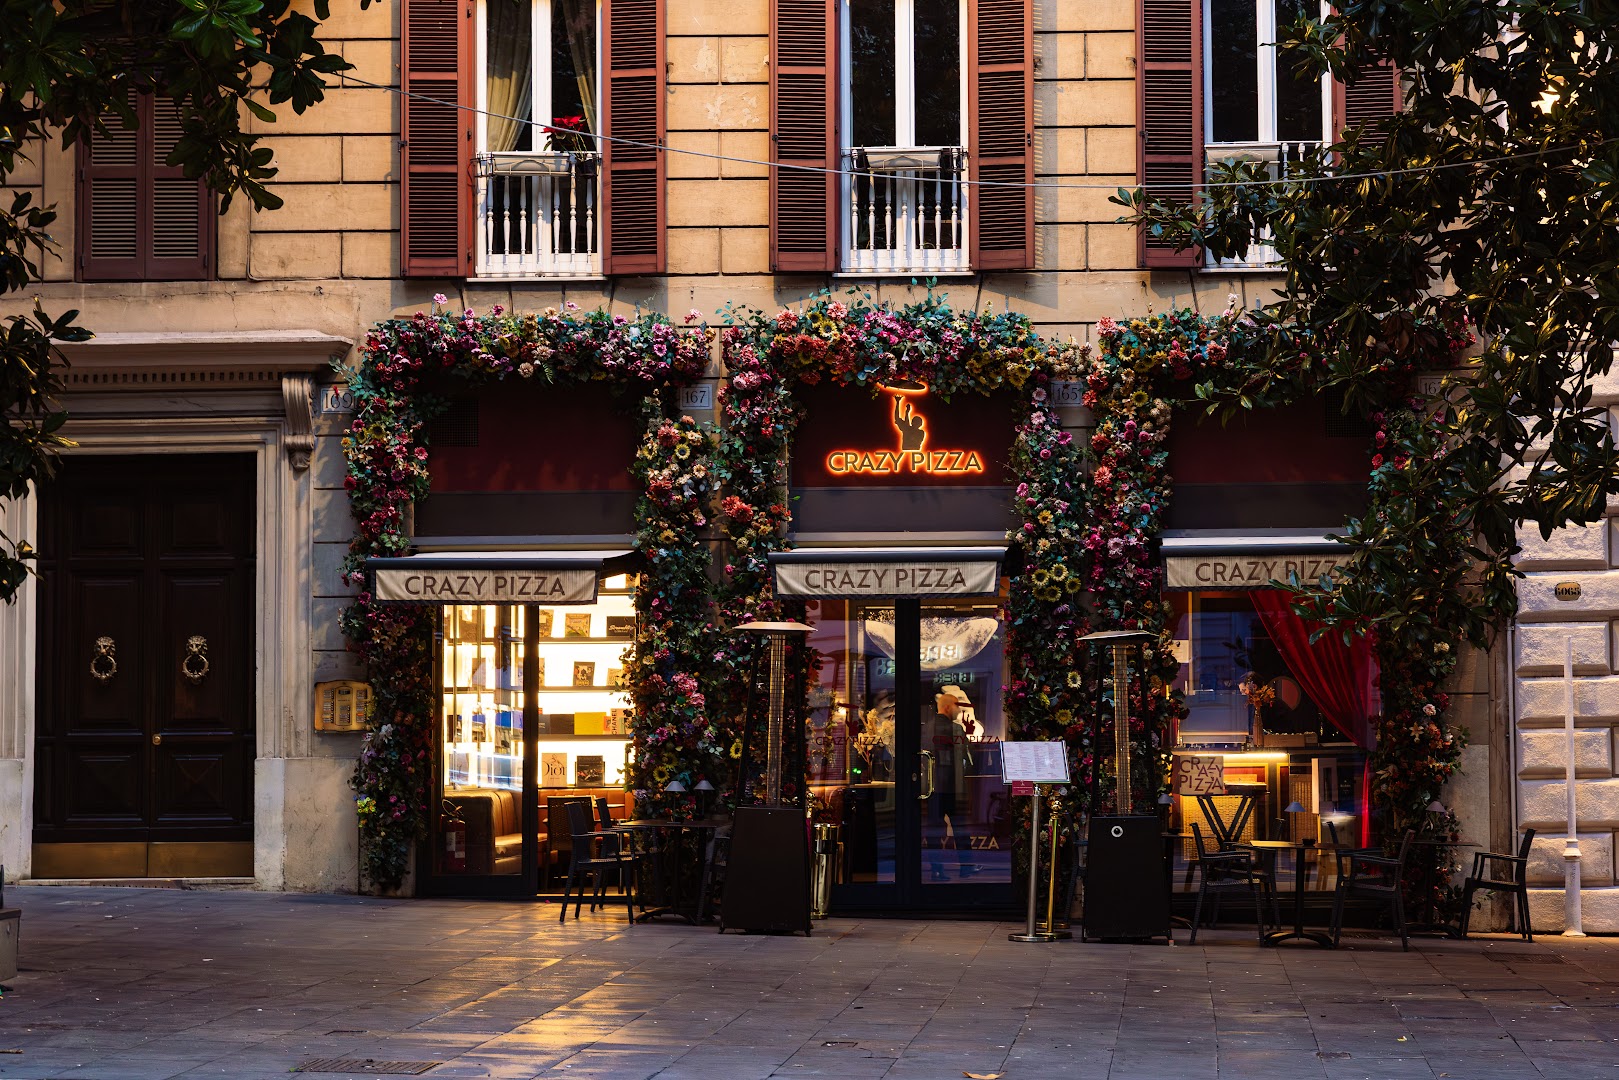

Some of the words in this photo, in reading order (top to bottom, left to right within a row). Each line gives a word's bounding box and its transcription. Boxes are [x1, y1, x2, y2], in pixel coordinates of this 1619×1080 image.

[685, 390, 707, 404] 167
[1057, 387, 1078, 401] 165
[828, 451, 905, 472] CRAZY
[911, 451, 982, 472] PIZZA
[805, 569, 888, 589] CRAZY
[895, 568, 967, 588] PIZZA
[1195, 561, 1278, 582] CRAZY
[405, 576, 488, 595] CRAZY
[494, 576, 566, 595] PIZZA
[816, 736, 850, 746] CRAZY
[853, 736, 885, 746] PIZZA
[932, 735, 967, 745] CRAZY
[969, 735, 1000, 745] PIZZA
[1180, 757, 1224, 777] CRAZY
[1179, 775, 1223, 795] PIZZA
